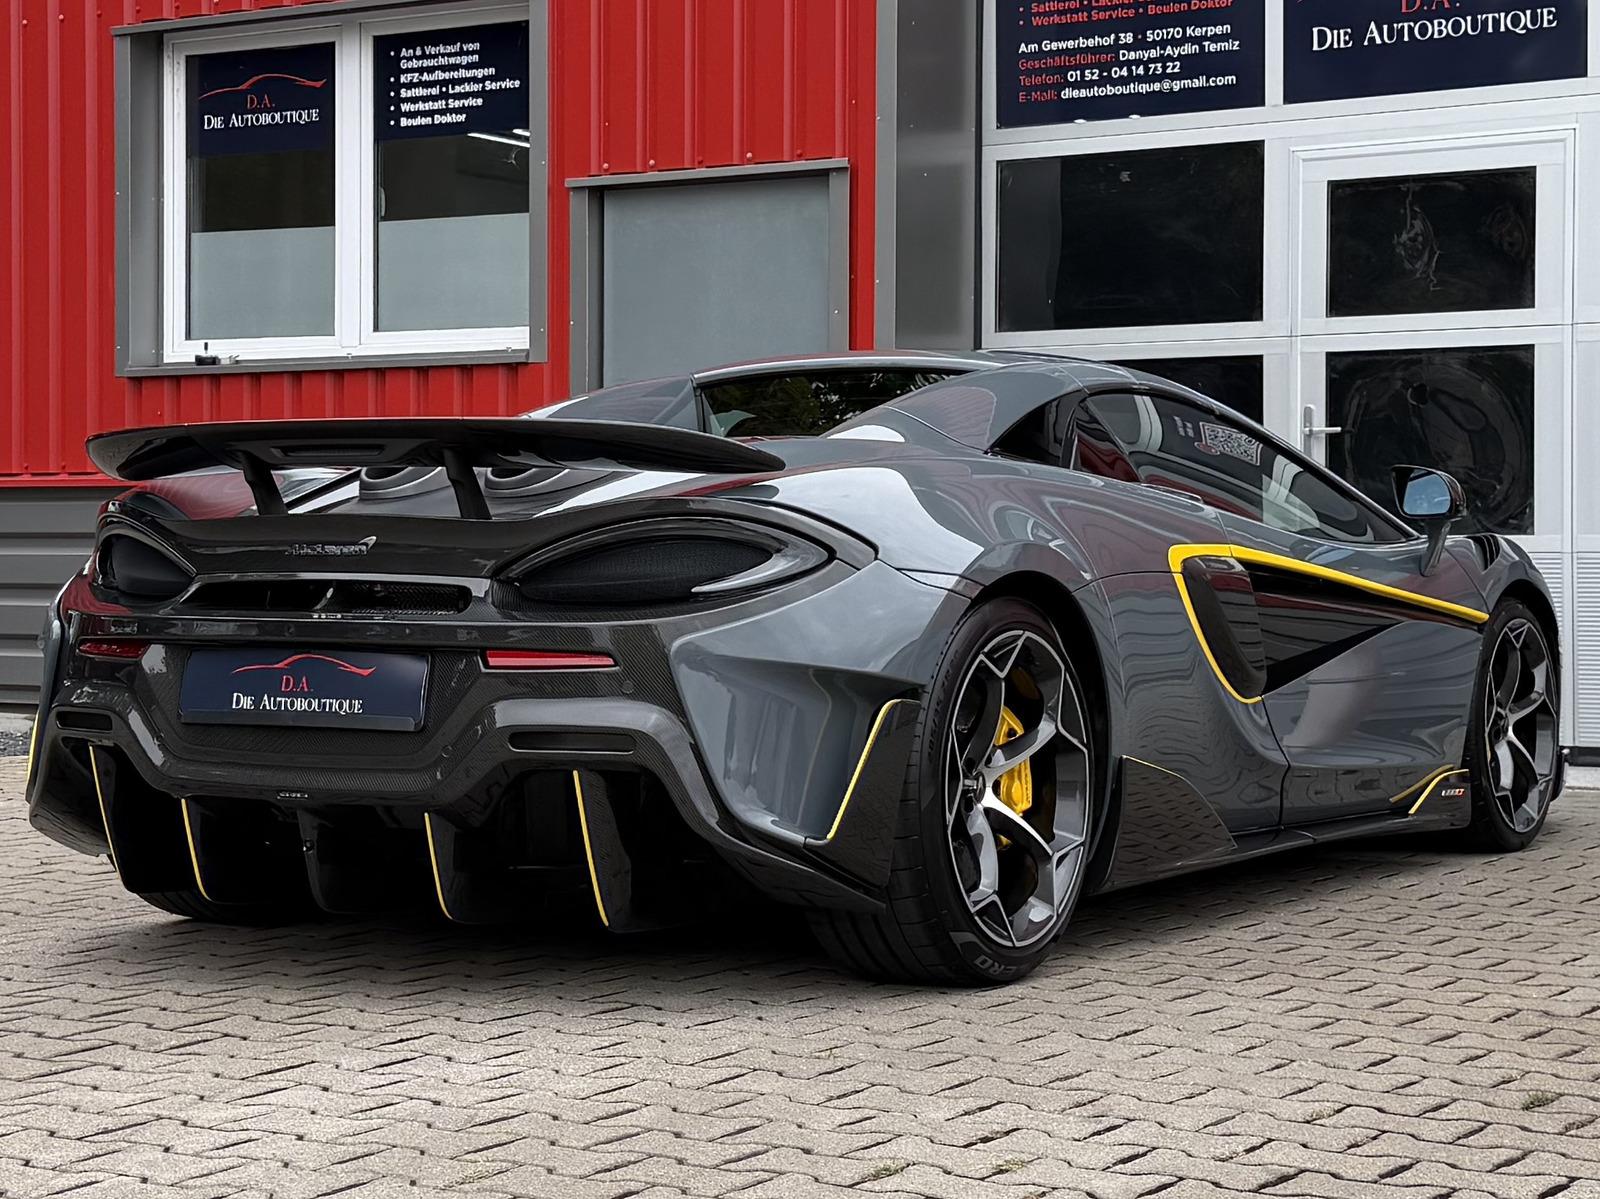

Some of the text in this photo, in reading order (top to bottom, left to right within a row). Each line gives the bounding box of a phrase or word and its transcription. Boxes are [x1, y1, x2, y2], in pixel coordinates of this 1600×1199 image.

[1031, 12, 1089, 26] Werkstatt
[1091, 8, 1135, 20] Service
[1147, 3, 1188, 15] Beulen
[1363, 7, 1558, 46] AUTOBOUTIQUE
[1018, 24, 1231, 54] Am Gewerbehof 38 50170 Kerpen
[400, 48, 413, 58] An
[424, 42, 461, 55] Verkauf
[462, 42, 480, 51] von
[1119, 42, 1200, 61] Danyal-Aydin
[1202, 39, 1240, 53] Temiz
[400, 54, 479, 69] Gebrauchtwagen
[400, 67, 496, 83] KFZ-Aufbereitungen
[1019, 73, 1064, 86] Telefon:
[1067, 70, 1081, 82] 01
[1084, 68, 1100, 81] 52
[1111, 66, 1128, 78] 04
[1131, 65, 1145, 77] 14
[1148, 63, 1162, 75] 73
[1165, 61, 1181, 74] 22
[400, 78, 520, 98] Sattlerei Lackier Service
[1018, 74, 1237, 102] E-Mail: dieautoboutique@gmail.com
[247, 93, 276, 109] D.A.
[400, 97, 484, 113] Werkstatt Service
[229, 108, 320, 128] AUTOBOUTIQUE
[400, 113, 467, 127] Beulen Doktor
[280, 675, 314, 692] D.A.
[259, 693, 363, 716] AUTOBOUTIQUE
